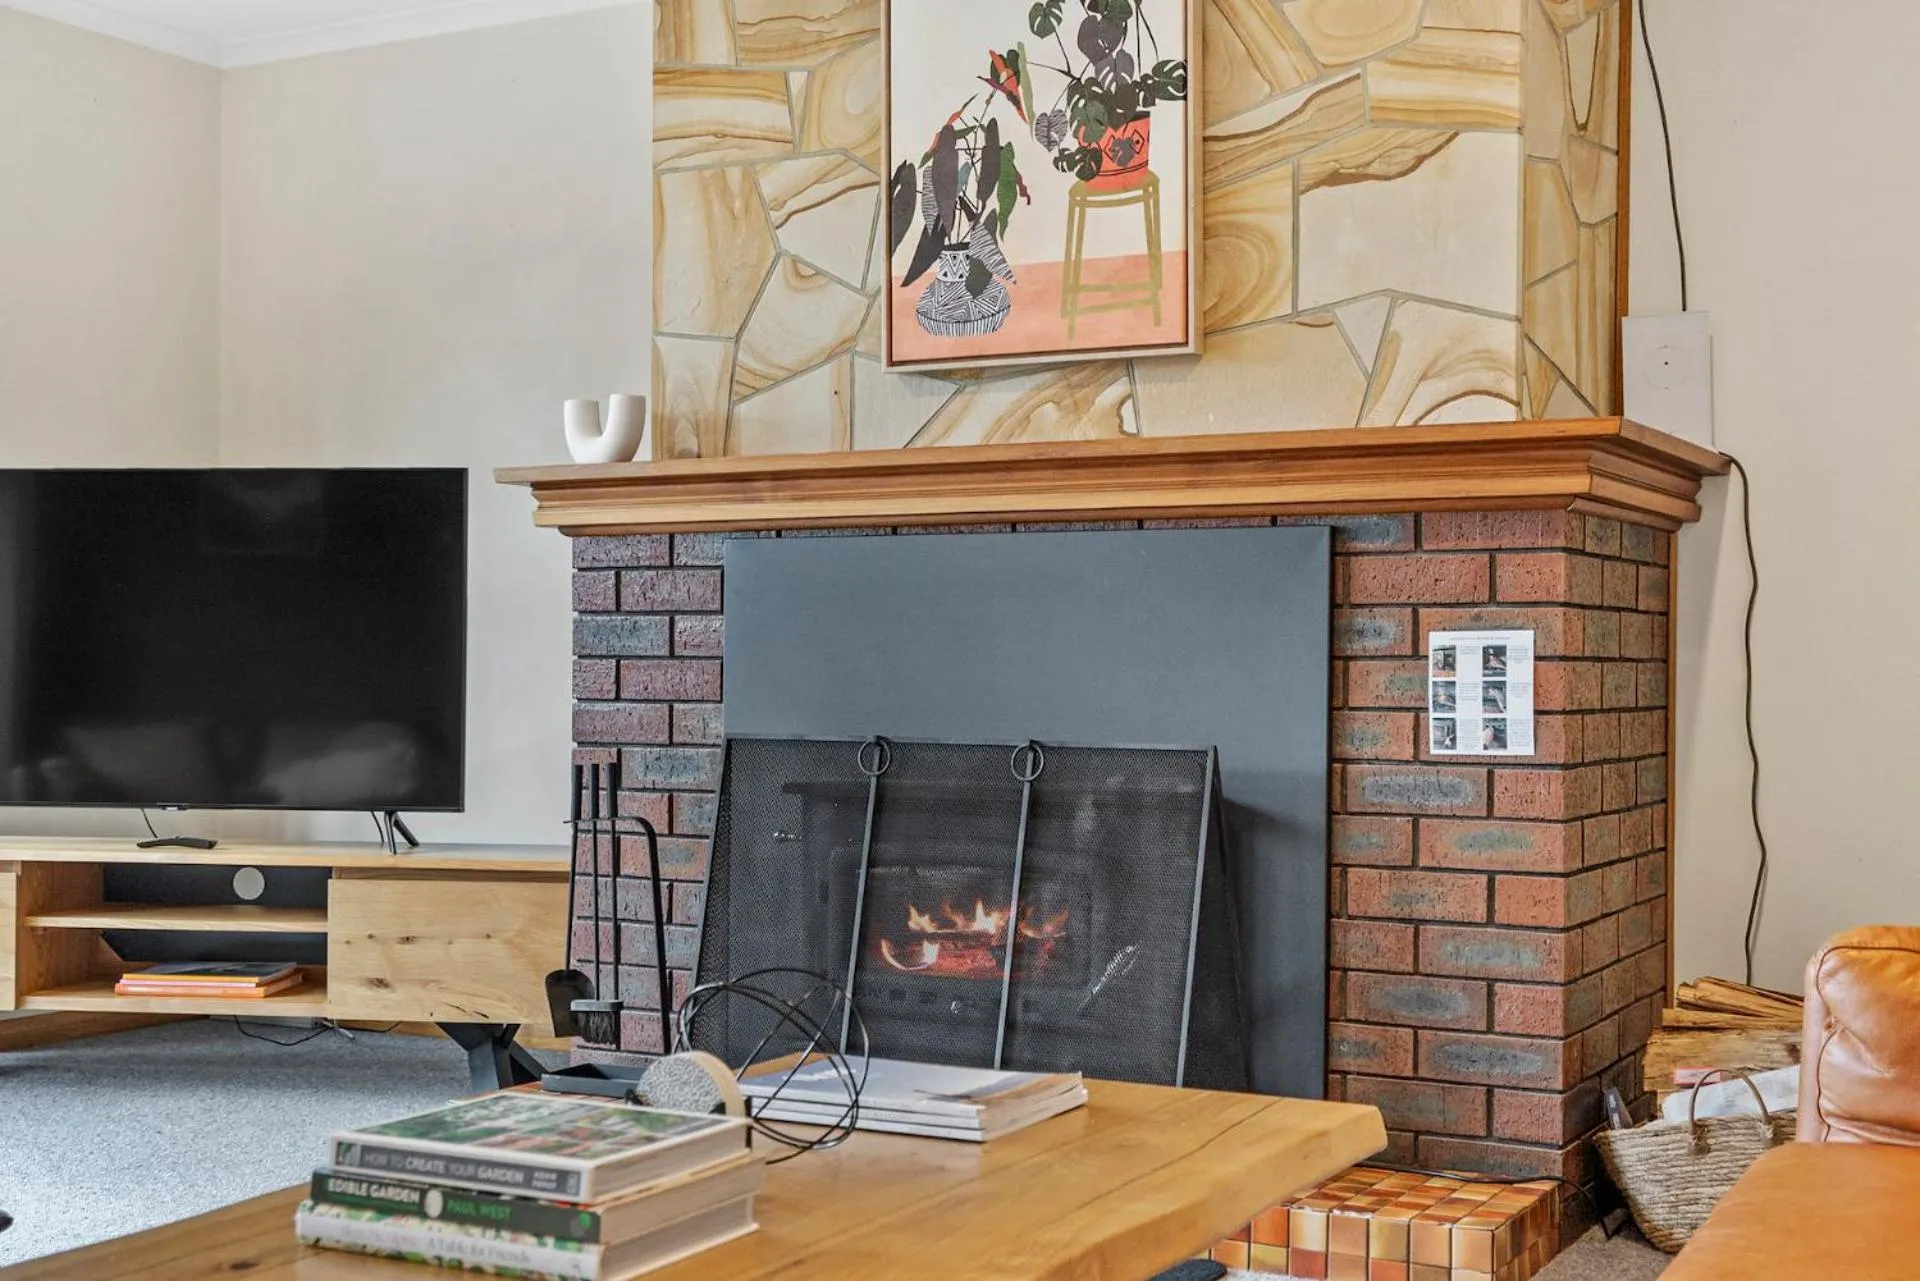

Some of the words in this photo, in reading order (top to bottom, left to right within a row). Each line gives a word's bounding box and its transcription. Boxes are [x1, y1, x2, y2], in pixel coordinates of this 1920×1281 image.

[364, 1152, 388, 1166] HOW
[405, 1157, 446, 1174] CREATE
[448, 1163, 475, 1177] YOUR
[477, 1166, 524, 1184] GARDEN
[327, 1179, 368, 1197] EDIBLE
[370, 1183, 420, 1203] GARDEN
[447, 1200, 477, 1216] PAUL
[480, 1204, 511, 1220] WEST
